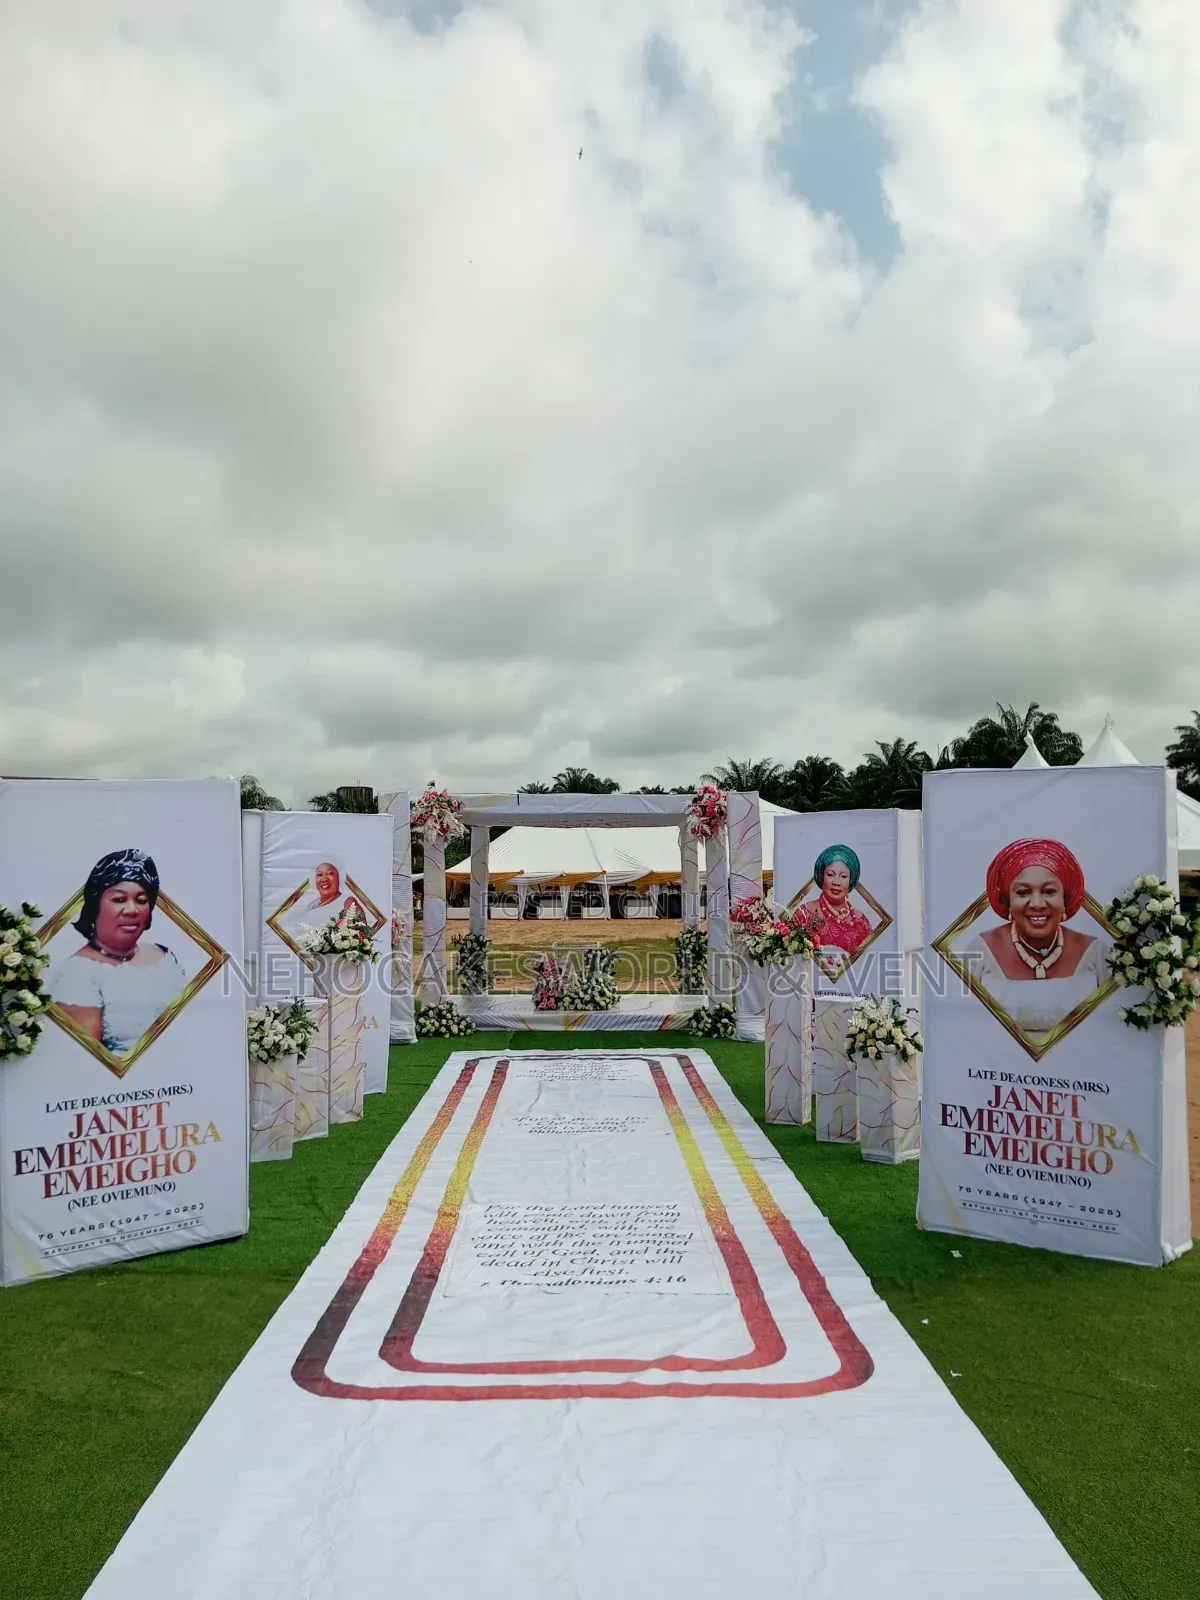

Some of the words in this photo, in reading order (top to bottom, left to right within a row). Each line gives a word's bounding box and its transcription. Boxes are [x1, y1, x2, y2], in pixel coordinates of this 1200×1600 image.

[968, 1068, 998, 1081] LATE
[1000, 1071, 1070, 1090] DEACONESS
[1072, 1080, 1110, 1096] (MRS.)
[45, 1096, 79, 1114] LATE
[81, 1088, 156, 1109] DEACONESS
[157, 1084, 194, 1099] (MRS.)
[986, 1084, 1087, 1119] JANET
[68, 1101, 171, 1140] JANET
[938, 1102, 1142, 1154] EMEMELURA
[12, 1120, 223, 1177] EMEMELURA
[963, 1131, 1115, 1176] EMEIGHO
[41, 1149, 198, 1199] EMEIGHO
[985, 1163, 1014, 1177] (NEE
[1016, 1168, 1093, 1190] OVIEMUNO)
[67, 1194, 100, 1213] (NEE
[101, 1181, 177, 1204] OVIEMUNO)
[958, 1185, 972, 1194] 76
[977, 1188, 1019, 1201] YEARS
[962, 1201, 1010, 1214] SATURDAY
[38, 1232, 55, 1242] 76
[60, 1222, 106, 1238] YEARS
[529, 1233, 550, 1242] of
[592, 1232, 694, 1240] archangel
[44, 1241, 97, 1256] SATURDAY
[474, 1241, 515, 1249] and
[521, 1239, 564, 1248] with
[572, 1239, 602, 1247] the
[609, 1239, 689, 1247] trumpet
[476, 1249, 517, 1258] call
[523, 1248, 550, 1258] of
[609, 1247, 649, 1256] and
[655, 1247, 688, 1255] the
[480, 1258, 536, 1268] dead
[541, 1258, 561, 1267] in
[570, 1256, 636, 1266] Christ
[645, 1255, 683, 1265] will
[533, 1269, 575, 1277] rise
[576, 1266, 630, 1276] first.
[499, 1277, 638, 1287] Thessalonians
[643, 1275, 688, 1284] 4:16
